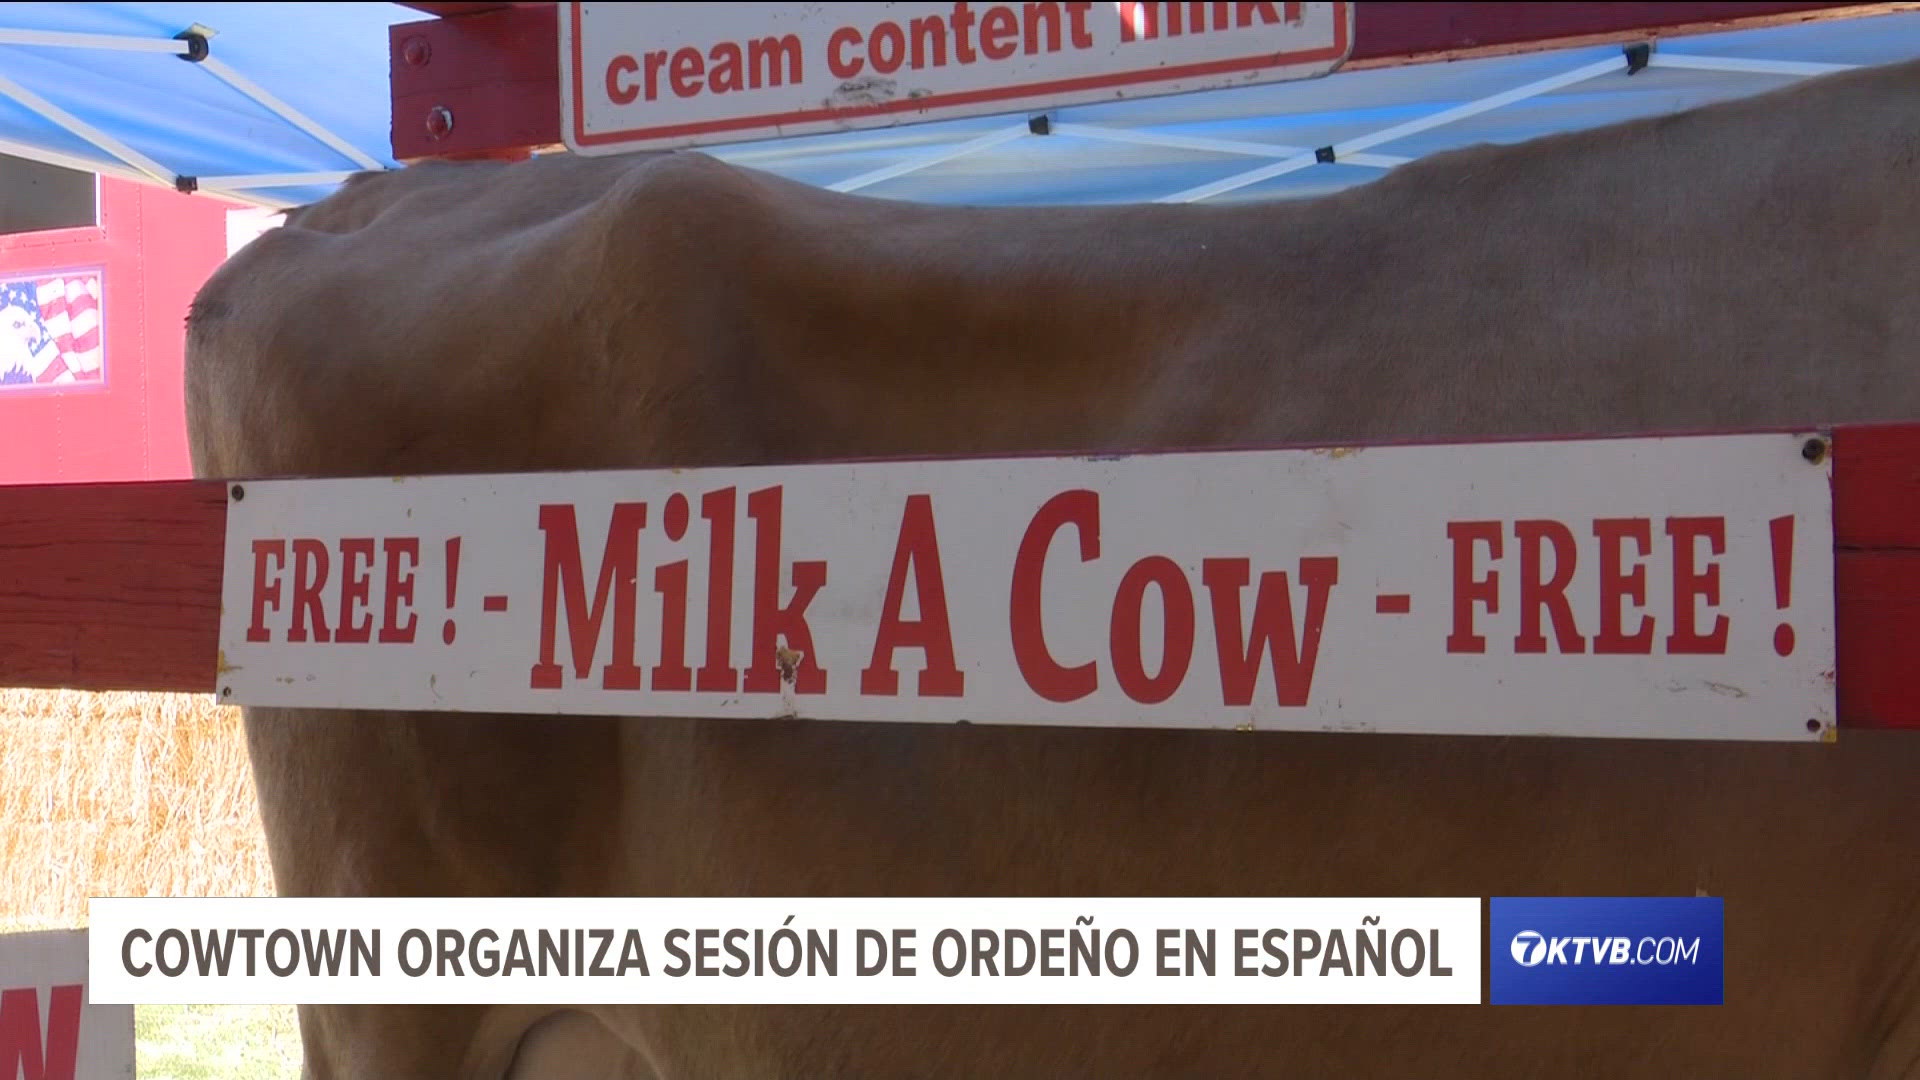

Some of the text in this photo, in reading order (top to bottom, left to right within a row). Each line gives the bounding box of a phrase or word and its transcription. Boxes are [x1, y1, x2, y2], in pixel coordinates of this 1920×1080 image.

[606, 34, 803, 105] cream
[827, 2, 1092, 79] content
[530, 485, 827, 695] Milk
[861, 493, 965, 697] A
[1009, 489, 1338, 705] Cow
